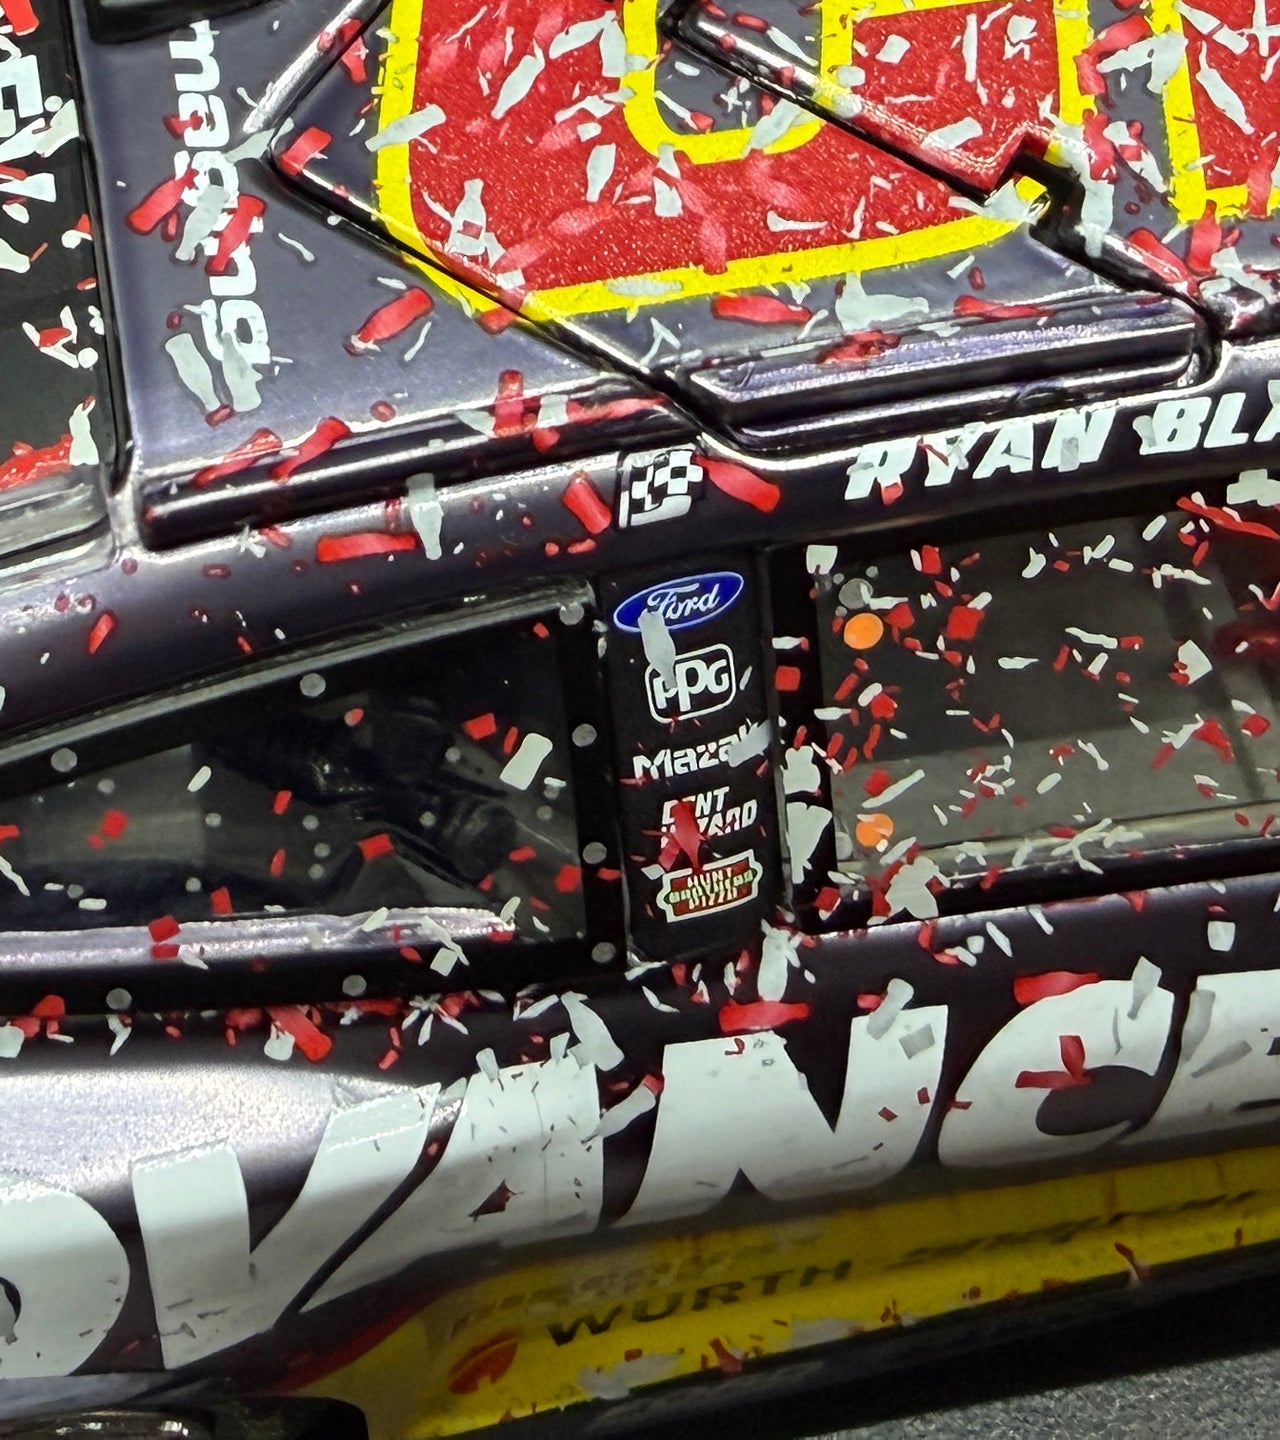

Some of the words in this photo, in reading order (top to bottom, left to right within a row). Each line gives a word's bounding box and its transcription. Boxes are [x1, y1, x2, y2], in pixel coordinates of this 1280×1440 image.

[844, 406, 1117, 502] RYAN
[646, 582, 721, 621] Ford
[632, 722, 762, 781] Maza
[661, 786, 730, 825] DNT
